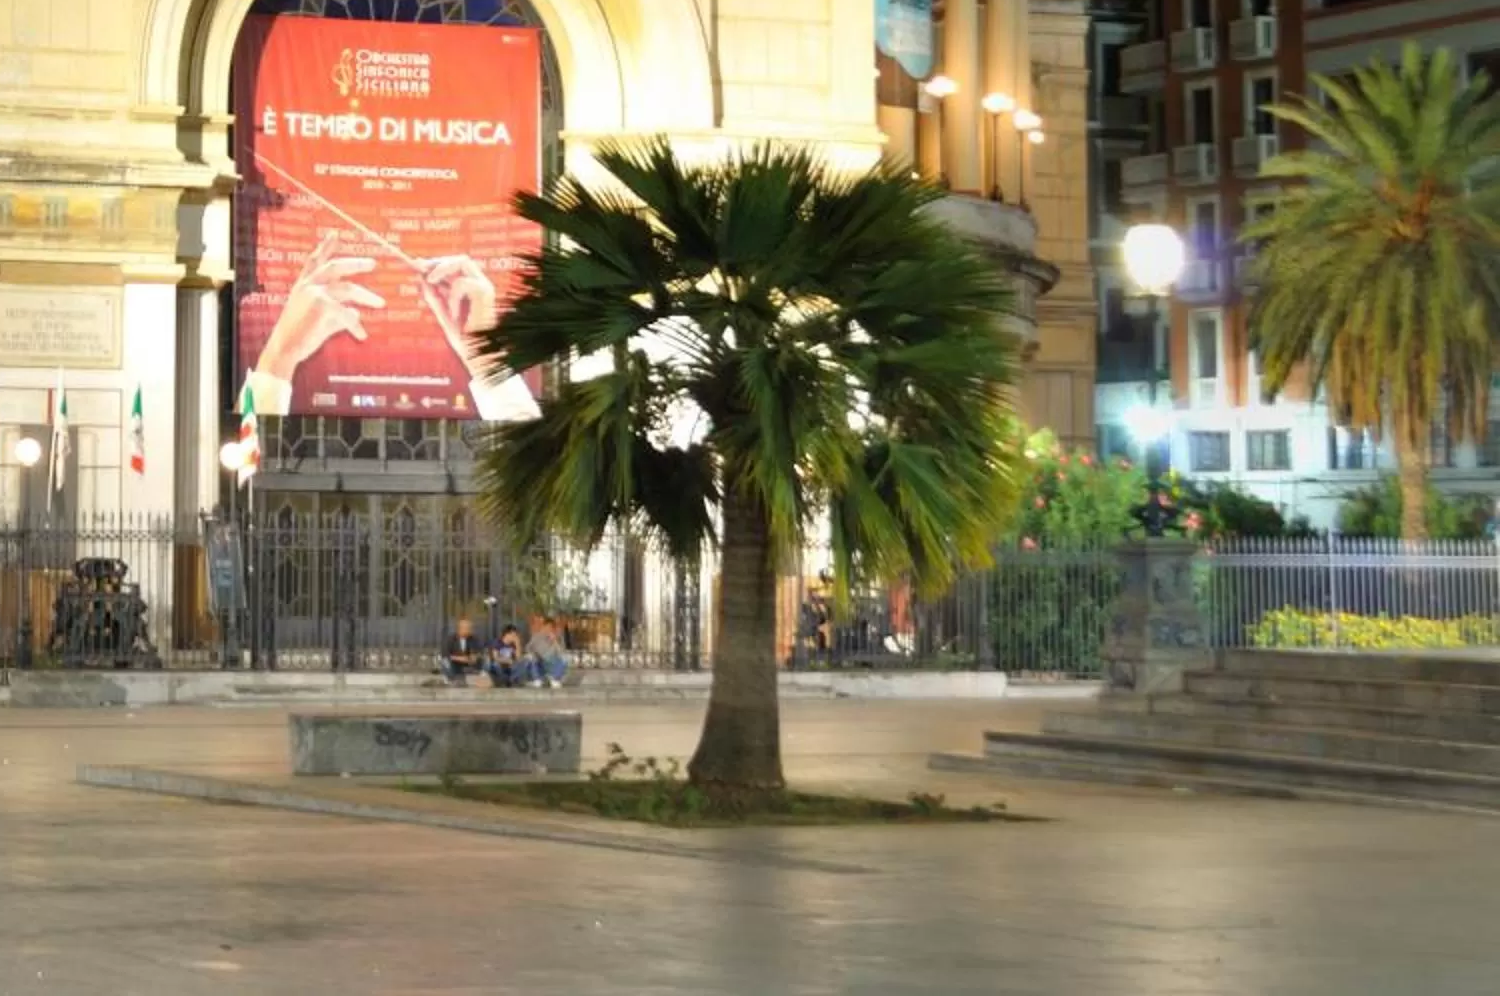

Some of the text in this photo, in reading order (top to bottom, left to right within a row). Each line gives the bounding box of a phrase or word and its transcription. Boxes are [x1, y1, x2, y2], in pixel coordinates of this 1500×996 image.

[263, 106, 511, 146] È TEMPO DI MUSICA
